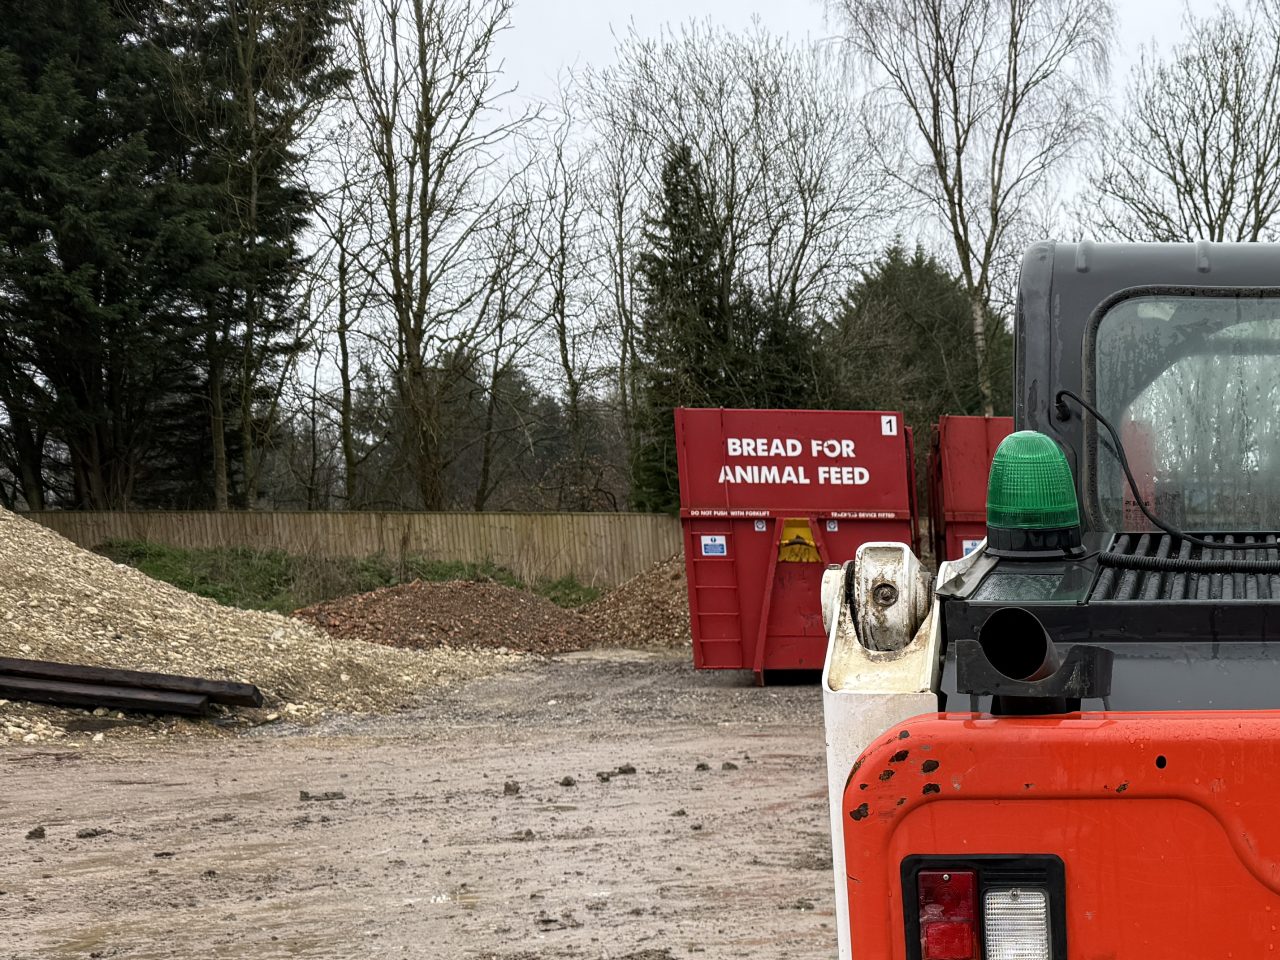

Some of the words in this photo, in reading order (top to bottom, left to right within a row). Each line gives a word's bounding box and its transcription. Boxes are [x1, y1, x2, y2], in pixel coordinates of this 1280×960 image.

[886, 418, 893, 433] 1
[727, 438, 803, 457] BREAD
[811, 439, 856, 458] FOR
[718, 465, 811, 485] ANIMAL
[818, 466, 870, 485] FEED
